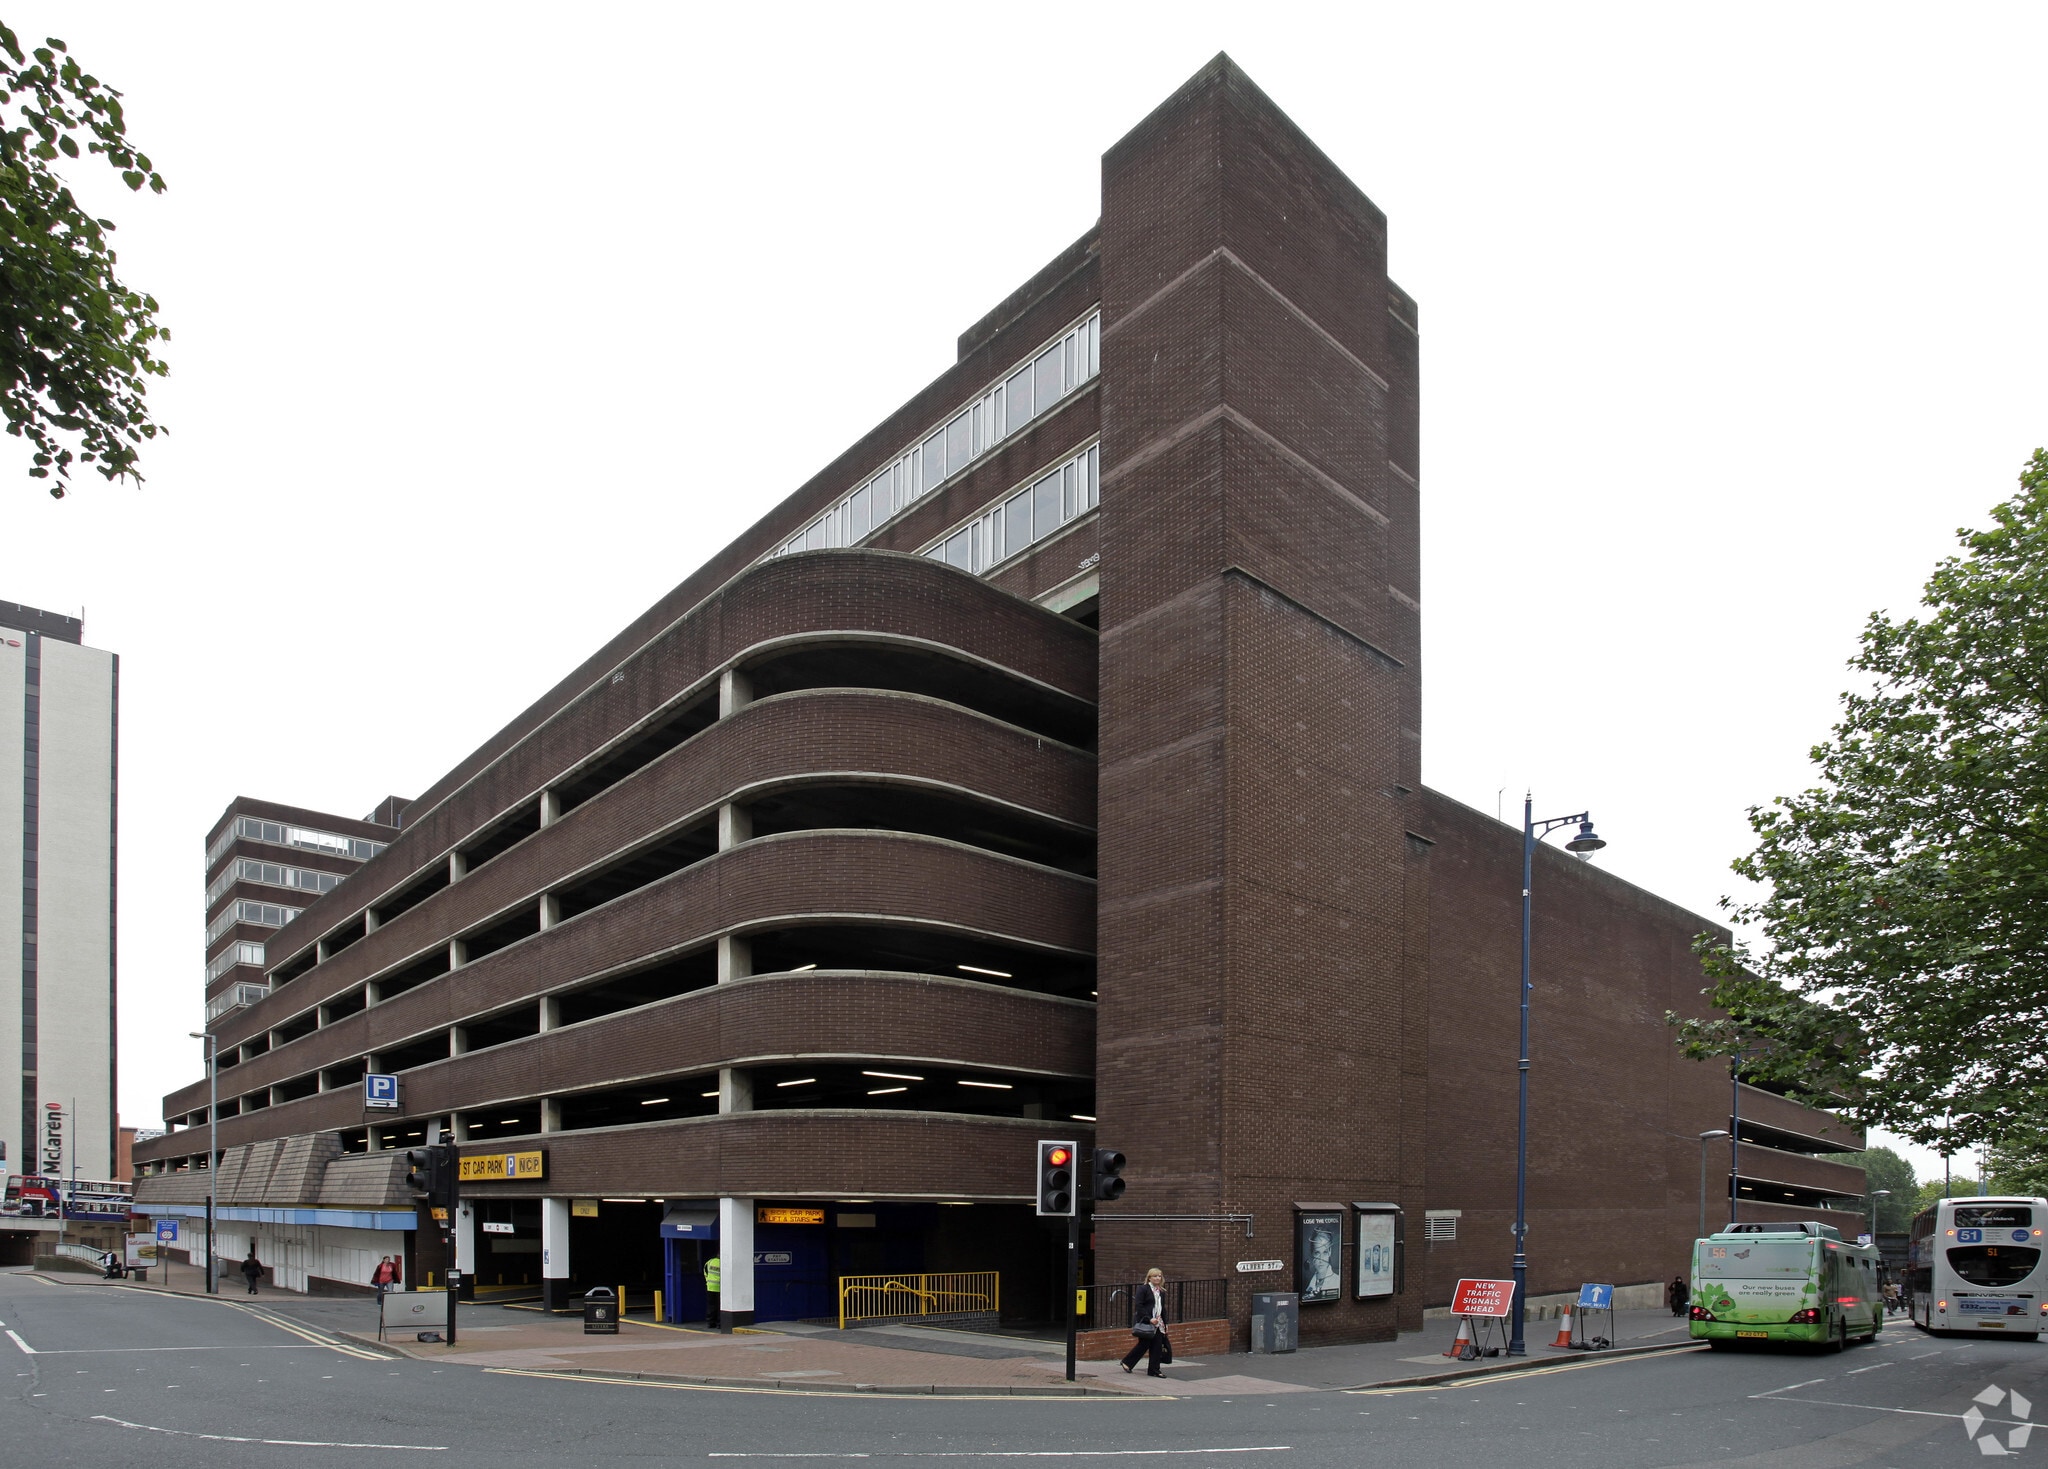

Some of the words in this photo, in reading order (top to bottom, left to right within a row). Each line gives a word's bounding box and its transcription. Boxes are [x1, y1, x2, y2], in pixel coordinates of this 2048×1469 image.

[373, 1077, 390, 1097] P
[463, 1161, 471, 1175] ST
[472, 1160, 486, 1175] CAR
[487, 1159, 503, 1174] PARK
[519, 1156, 540, 1173] NCP
[1960, 1230, 1977, 1241] 51
[1712, 1247, 1726, 1259] 56
[1987, 1247, 1999, 1257] 51
[1241, 1263, 1265, 1271] ALBERT
[1466, 1289, 1502, 1298] TRAFFIC
[1462, 1297, 1501, 1306] SIGNALS
[1463, 1305, 1495, 1313] AHEAD
